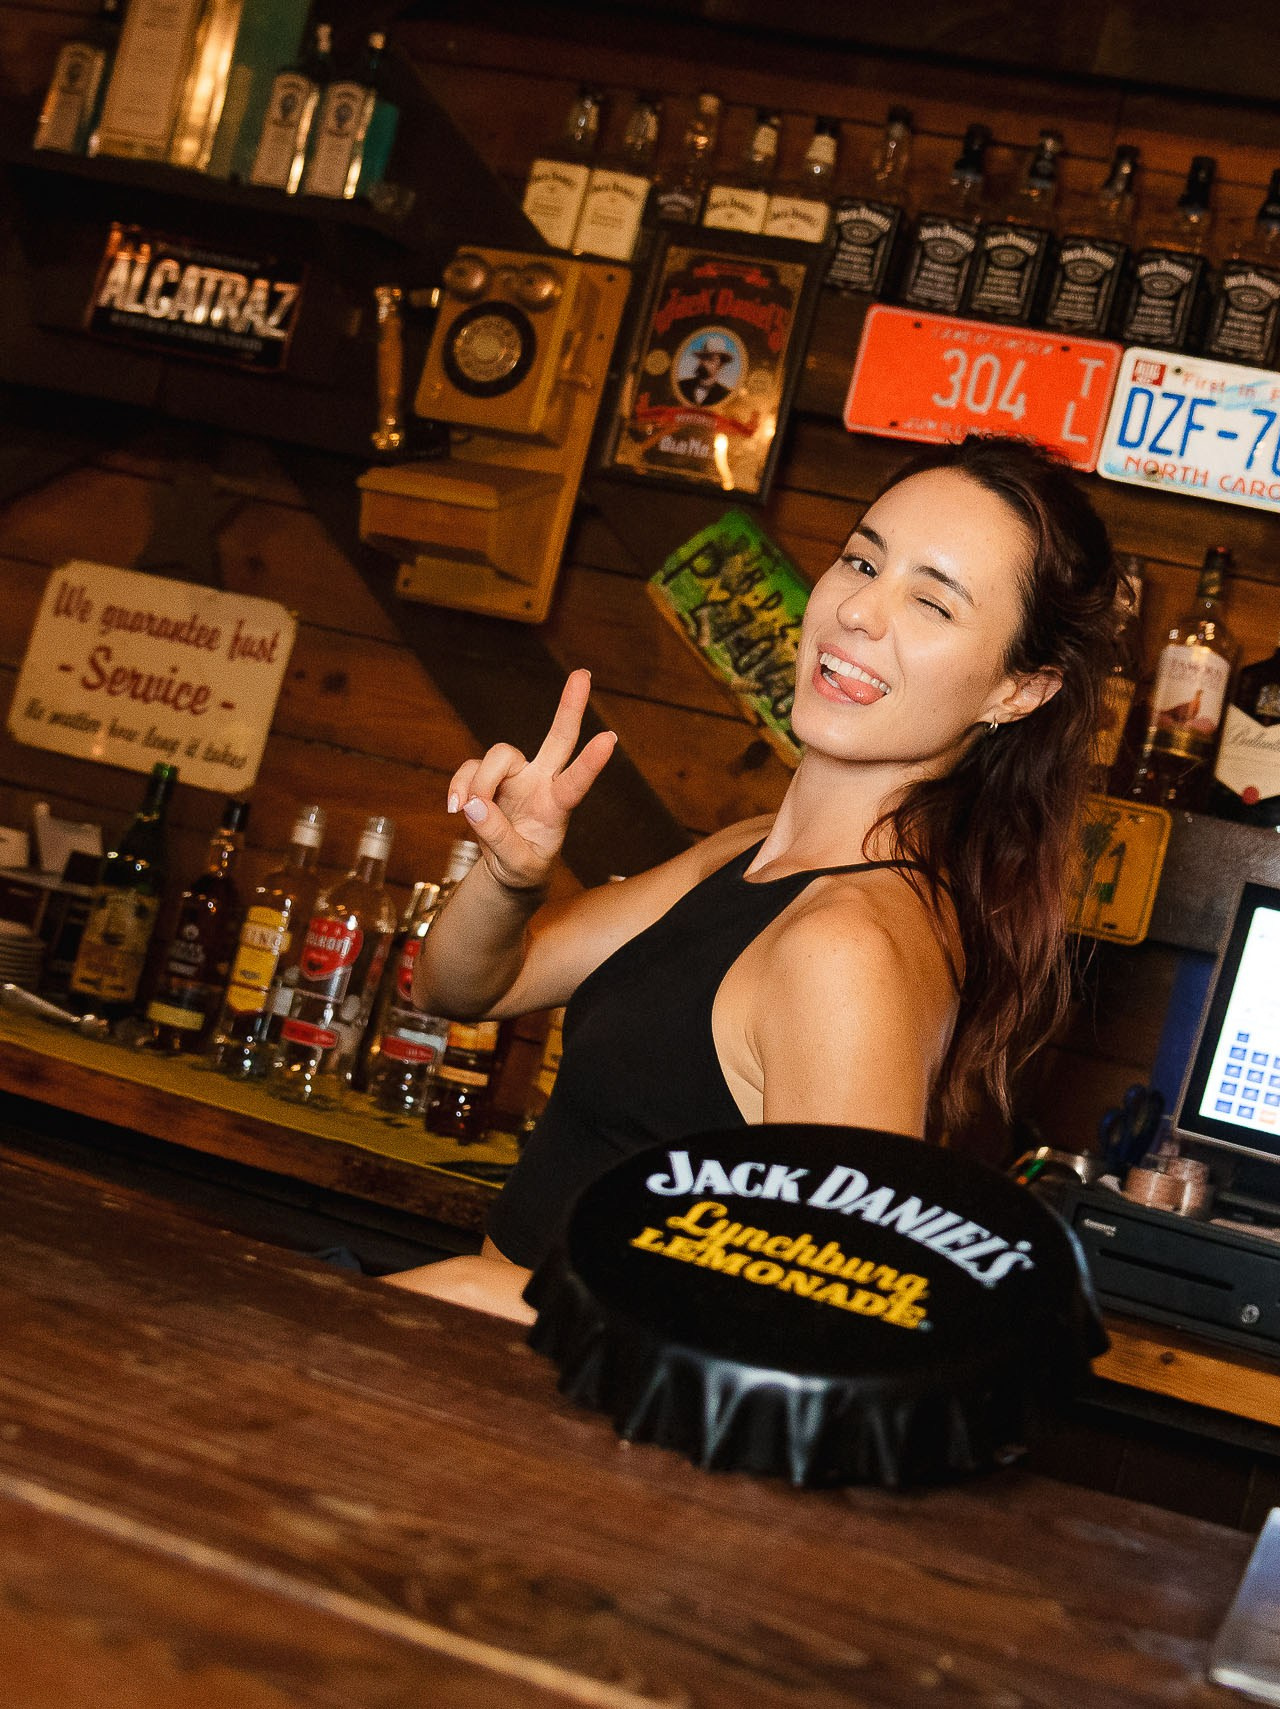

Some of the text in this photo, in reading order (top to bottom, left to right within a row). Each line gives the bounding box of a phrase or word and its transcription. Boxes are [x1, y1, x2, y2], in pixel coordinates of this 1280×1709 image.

[99, 252, 299, 339] ALCATRAZ
[932, 348, 1027, 421] 304
[1183, 371, 1226, 394] First
[1238, 381, 1257, 397] in
[1124, 455, 1210, 487] NORTH
[53, 580, 94, 624] We
[100, 604, 222, 652] guarantee
[80, 645, 212, 716] Service
[645, 1150, 808, 1201] JACK
[629, 1227, 928, 1330] LEMONADE
[665, 1200, 932, 1306] Lynchburg
